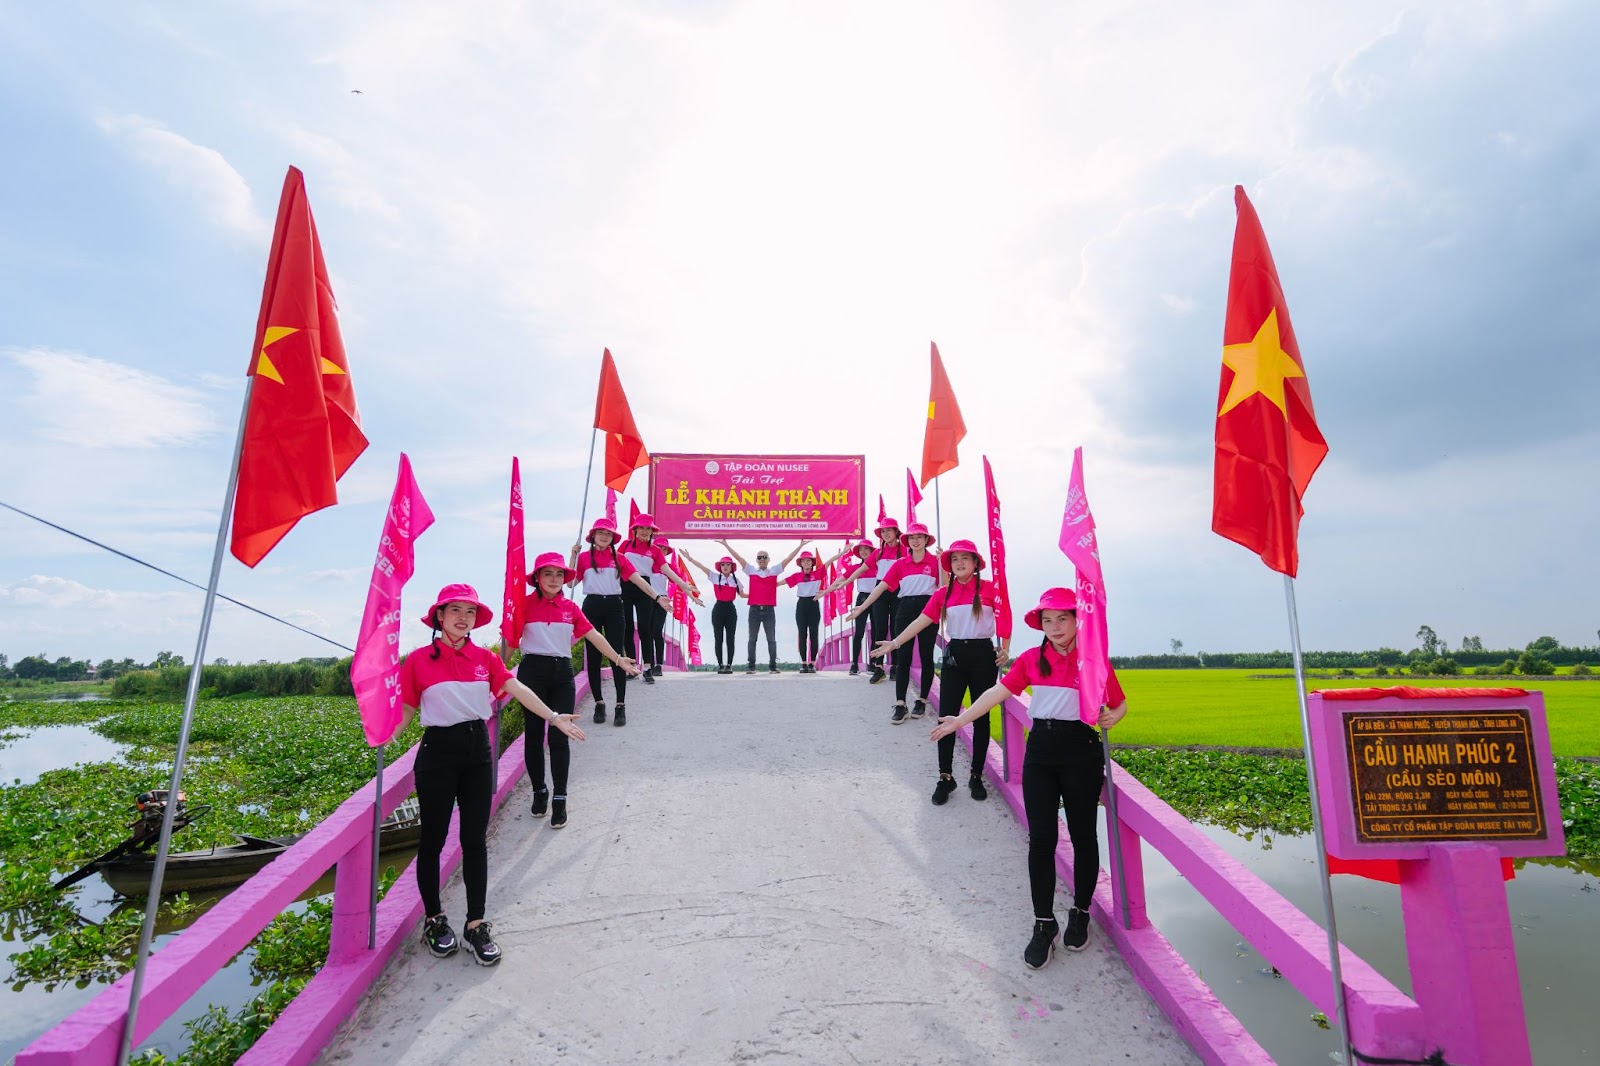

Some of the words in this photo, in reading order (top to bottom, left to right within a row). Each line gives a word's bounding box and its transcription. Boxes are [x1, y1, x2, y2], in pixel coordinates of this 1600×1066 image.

[723, 462, 743, 474] TẬP
[744, 461, 776, 473] ĐOÀN
[777, 463, 810, 473] NUSEE
[665, 480, 690, 505] LỄ
[695, 485, 771, 506] KHÁNH
[775, 485, 849, 506] THÀNH
[693, 506, 723, 519] CẦU
[727, 509, 767, 521] HẠNH
[770, 508, 808, 520] PHÚC
[811, 510, 821, 519] 2
[1077, 599, 1094, 613] HO
[1363, 737, 1397, 766] CẦU
[1403, 743, 1450, 769] HẠNH
[1455, 738, 1500, 764] PHÚC
[1506, 743, 1517, 764] 2
[1386, 769, 1421, 789] (CẦU
[1461, 769, 1502, 788] MÔN)
[1370, 822, 1391, 832] CÔNG
[1393, 823, 1402, 832] TY
[1438, 821, 1453, 832] TẬP
[1477, 821, 1501, 830] NUSEE
